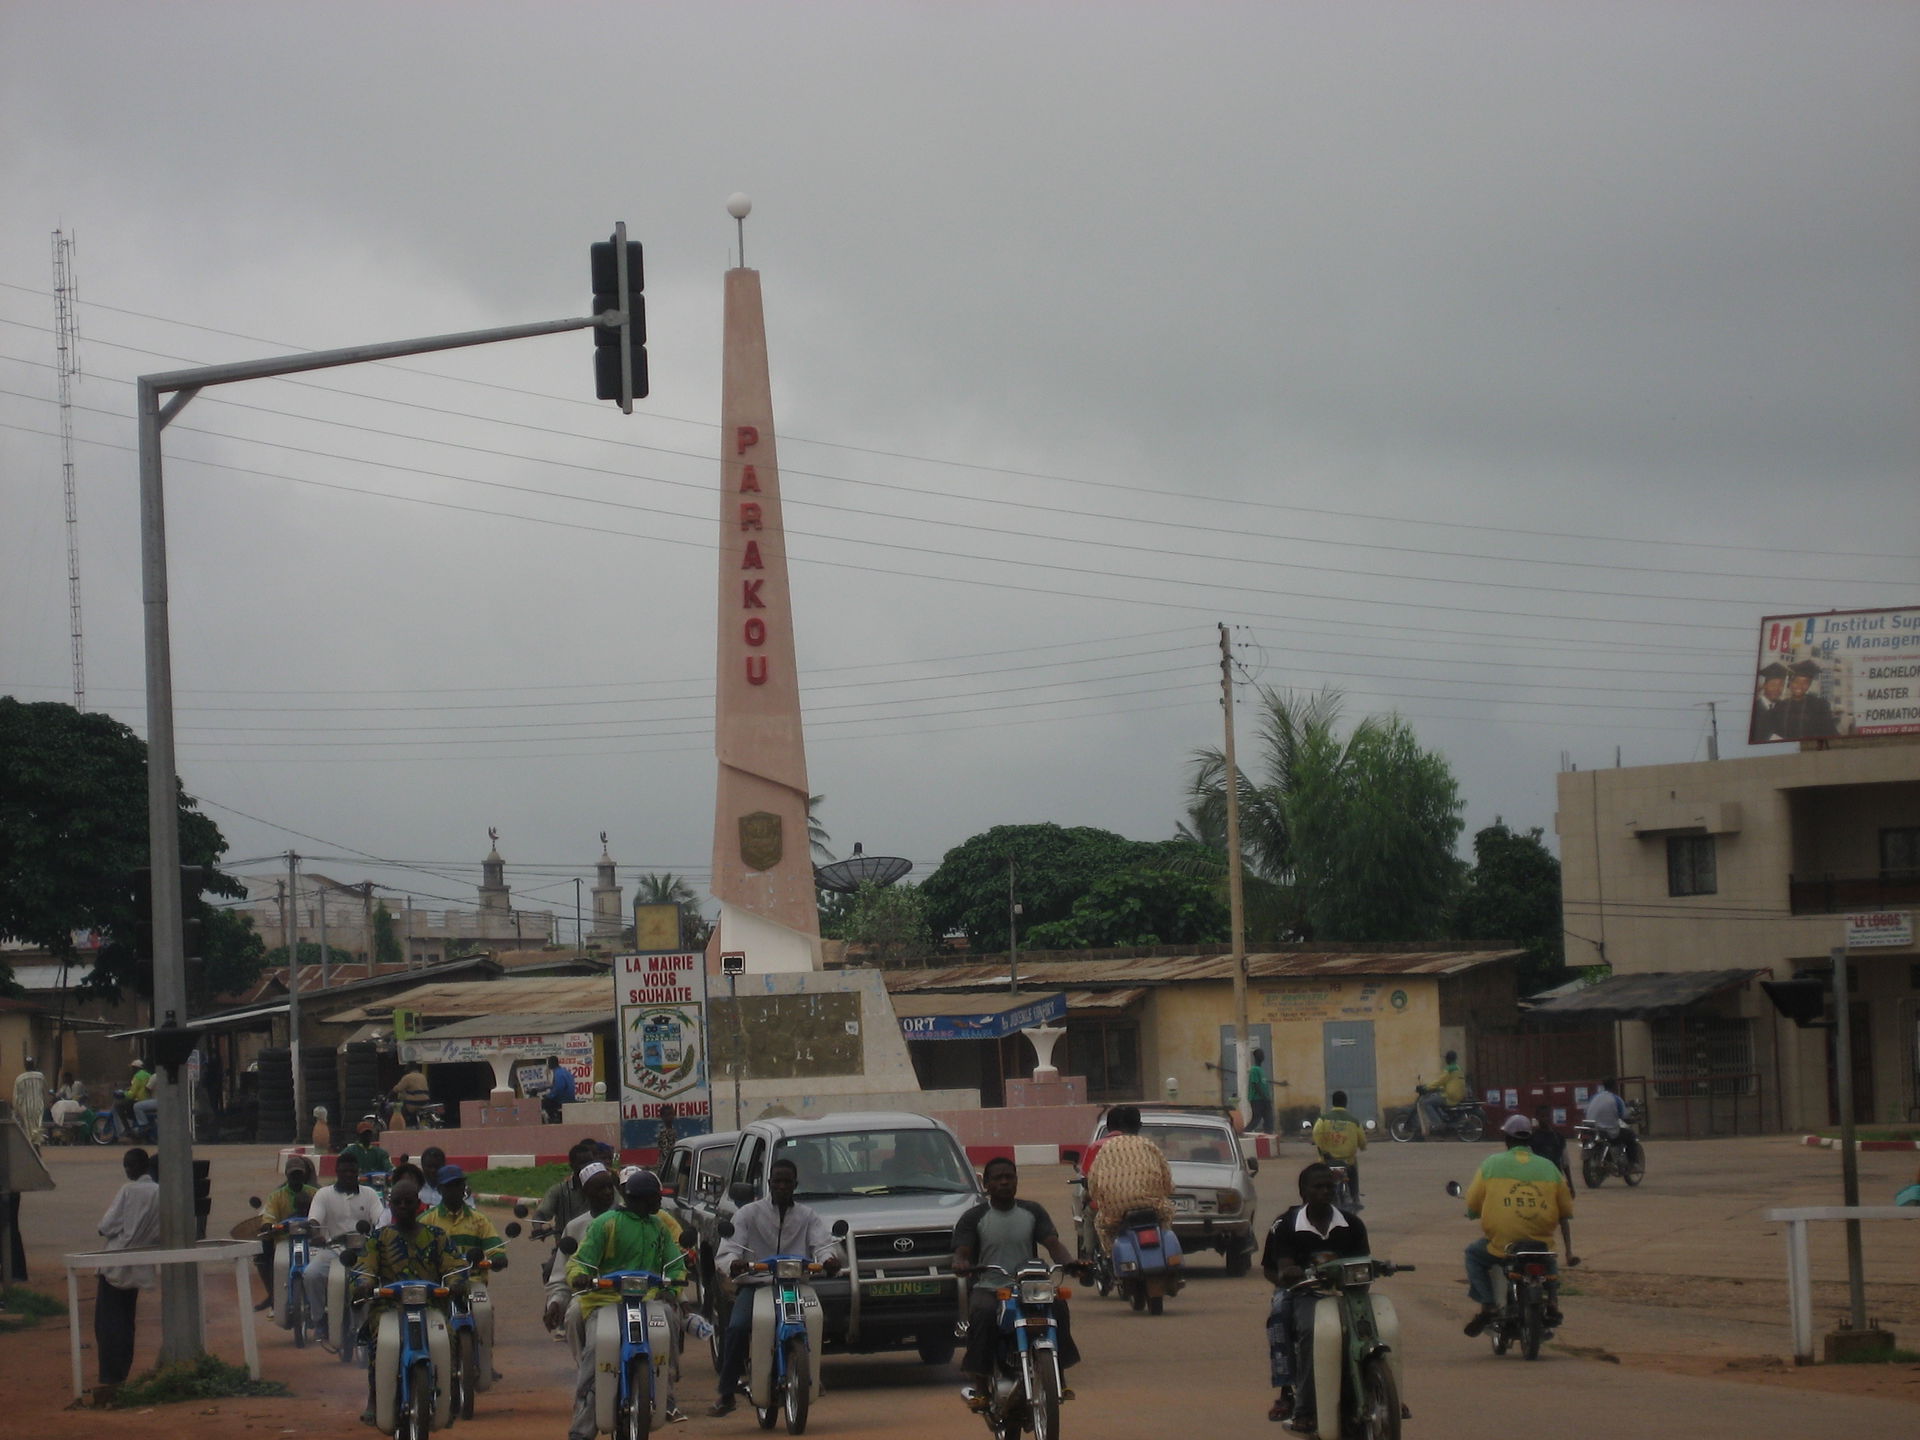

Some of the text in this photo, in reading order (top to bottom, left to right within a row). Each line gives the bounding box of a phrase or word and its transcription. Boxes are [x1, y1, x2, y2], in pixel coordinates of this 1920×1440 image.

[736, 426, 768, 686] PARAKOU
[1824, 616, 1886, 633] Institut
[1821, 637, 1840, 651] de
[1867, 687, 1909, 701] MASTER
[1865, 707, 1920, 721] FORMATIO
[625, 955, 693, 973] LA MAIRIE
[643, 971, 677, 988] VOUS
[629, 987, 692, 1004] SOUHAITE
[623, 1100, 709, 1120] LA BIEVENUE
